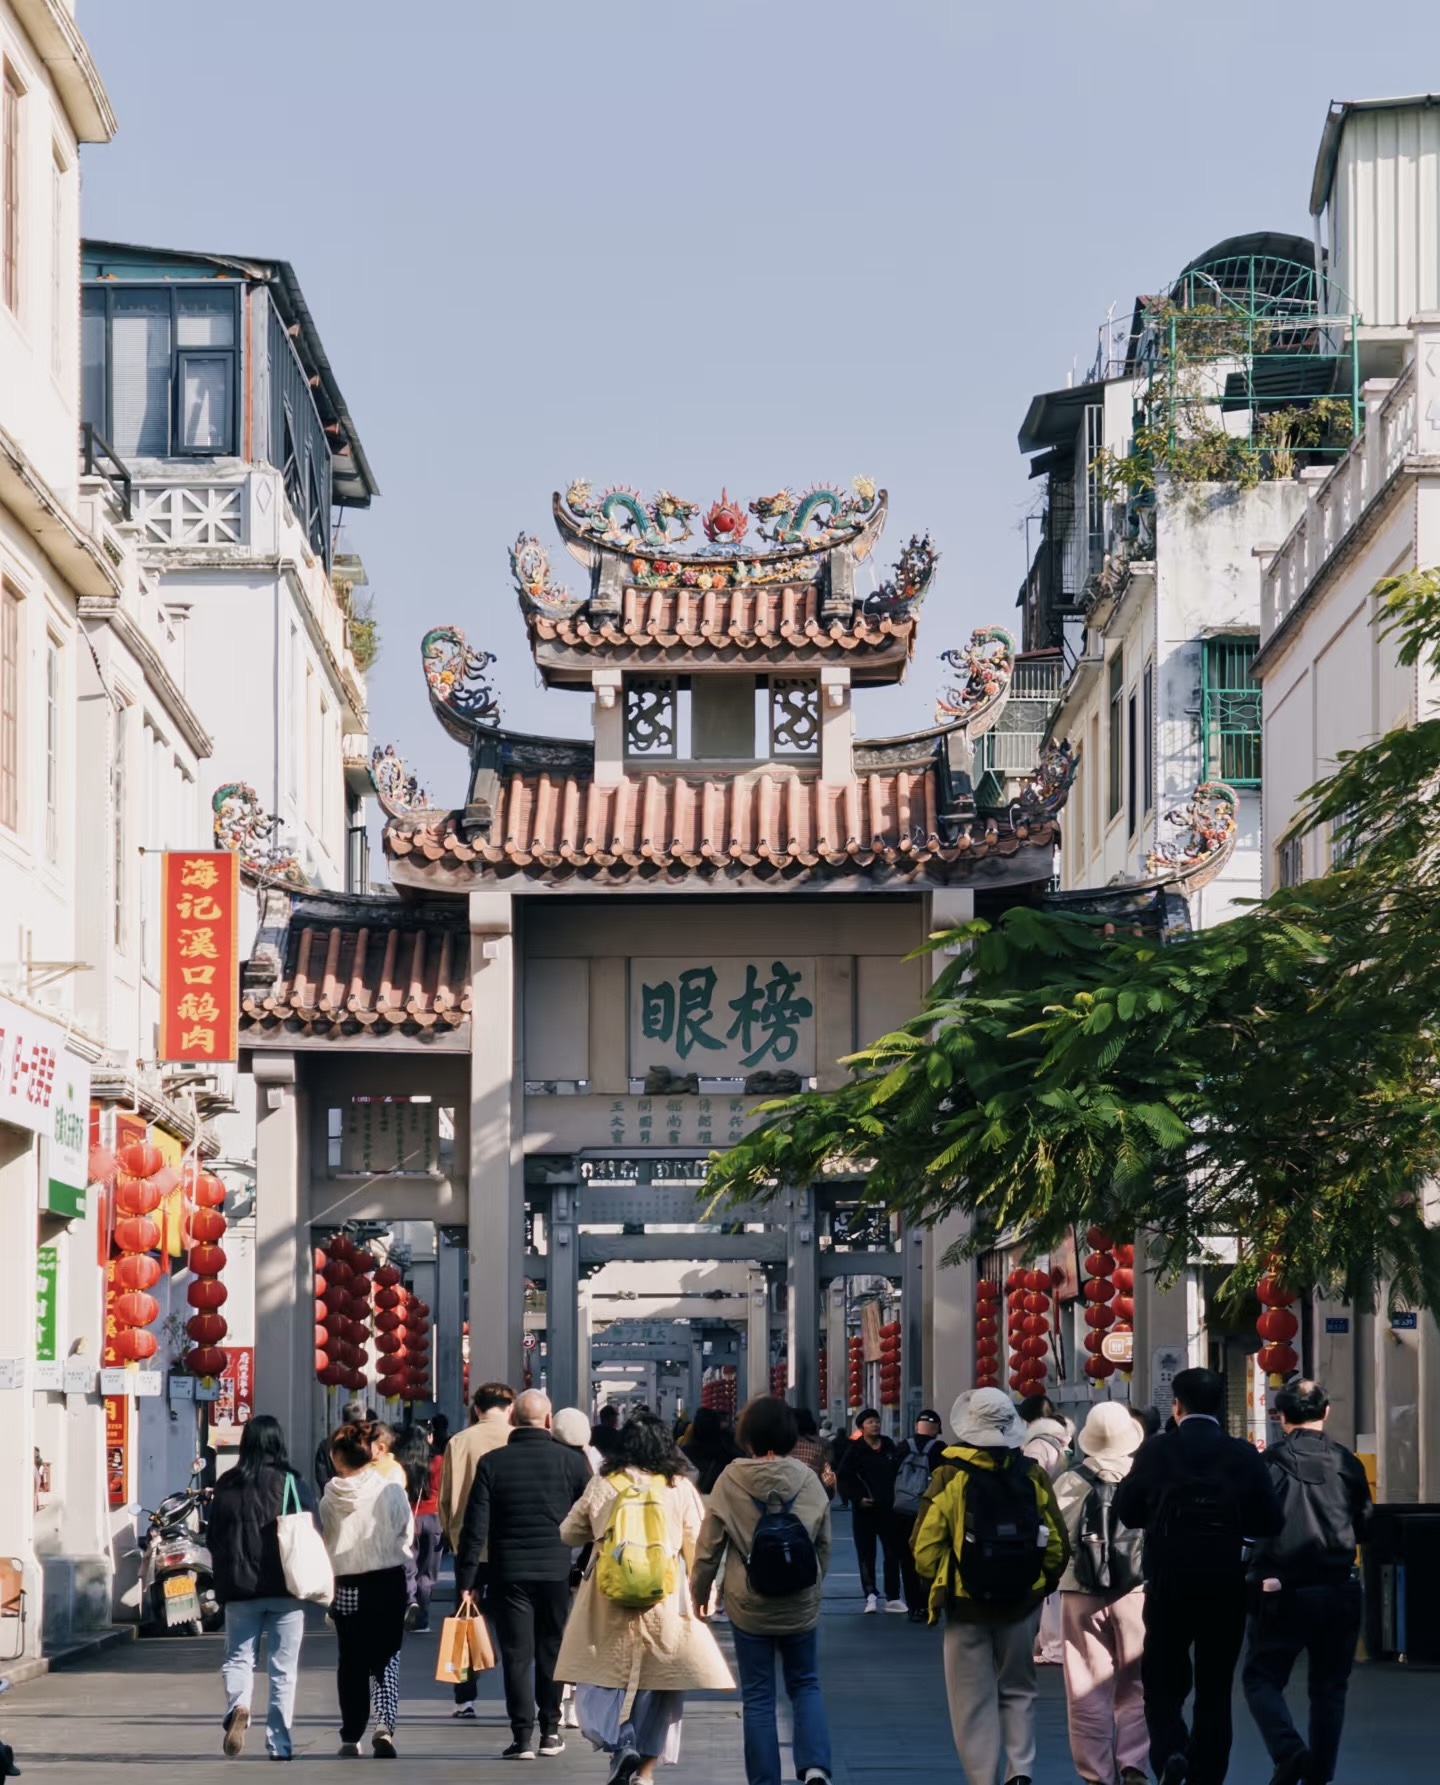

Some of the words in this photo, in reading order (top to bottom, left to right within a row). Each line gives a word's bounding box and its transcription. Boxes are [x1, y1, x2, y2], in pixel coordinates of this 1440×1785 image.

[176, 858, 223, 1054] 海记溪口鹅肉
